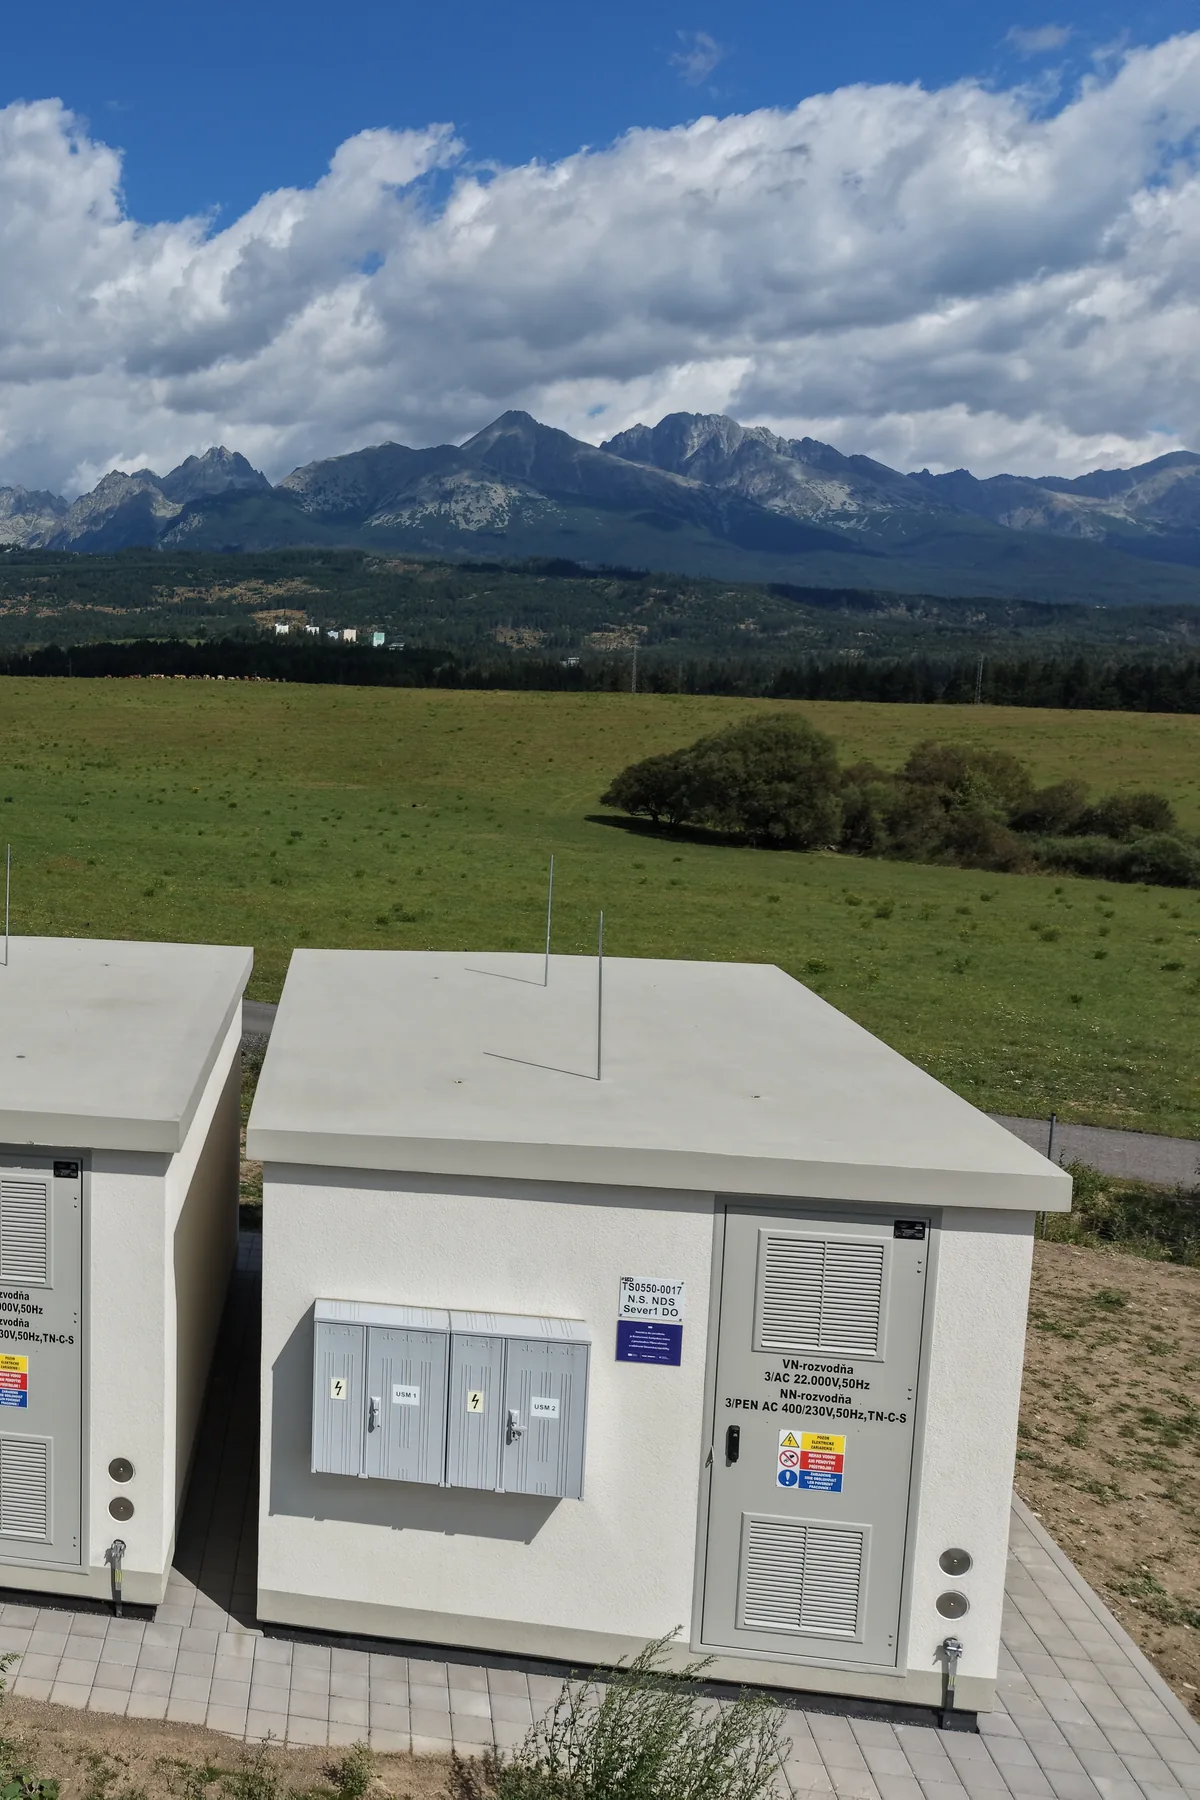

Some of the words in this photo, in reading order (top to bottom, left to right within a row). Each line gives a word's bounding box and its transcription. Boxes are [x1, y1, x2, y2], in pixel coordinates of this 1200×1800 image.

[622, 1282, 682, 1295] TS0550-0017
[628, 1295, 648, 1304] N.S.
[652, 1297, 675, 1306] NDS
[623, 1305, 658, 1315] Sever1
[662, 1308, 678, 1317] DO
[782, 1359, 854, 1374] VN-rozvodňa
[764, 1371, 790, 1383] 3/AC
[794, 1374, 870, 1390] 22.000V,50Hz
[780, 1389, 852, 1404] NN-rozvodňa
[725, 1398, 758, 1410] 3/PEN
[762, 1401, 778, 1412] AC
